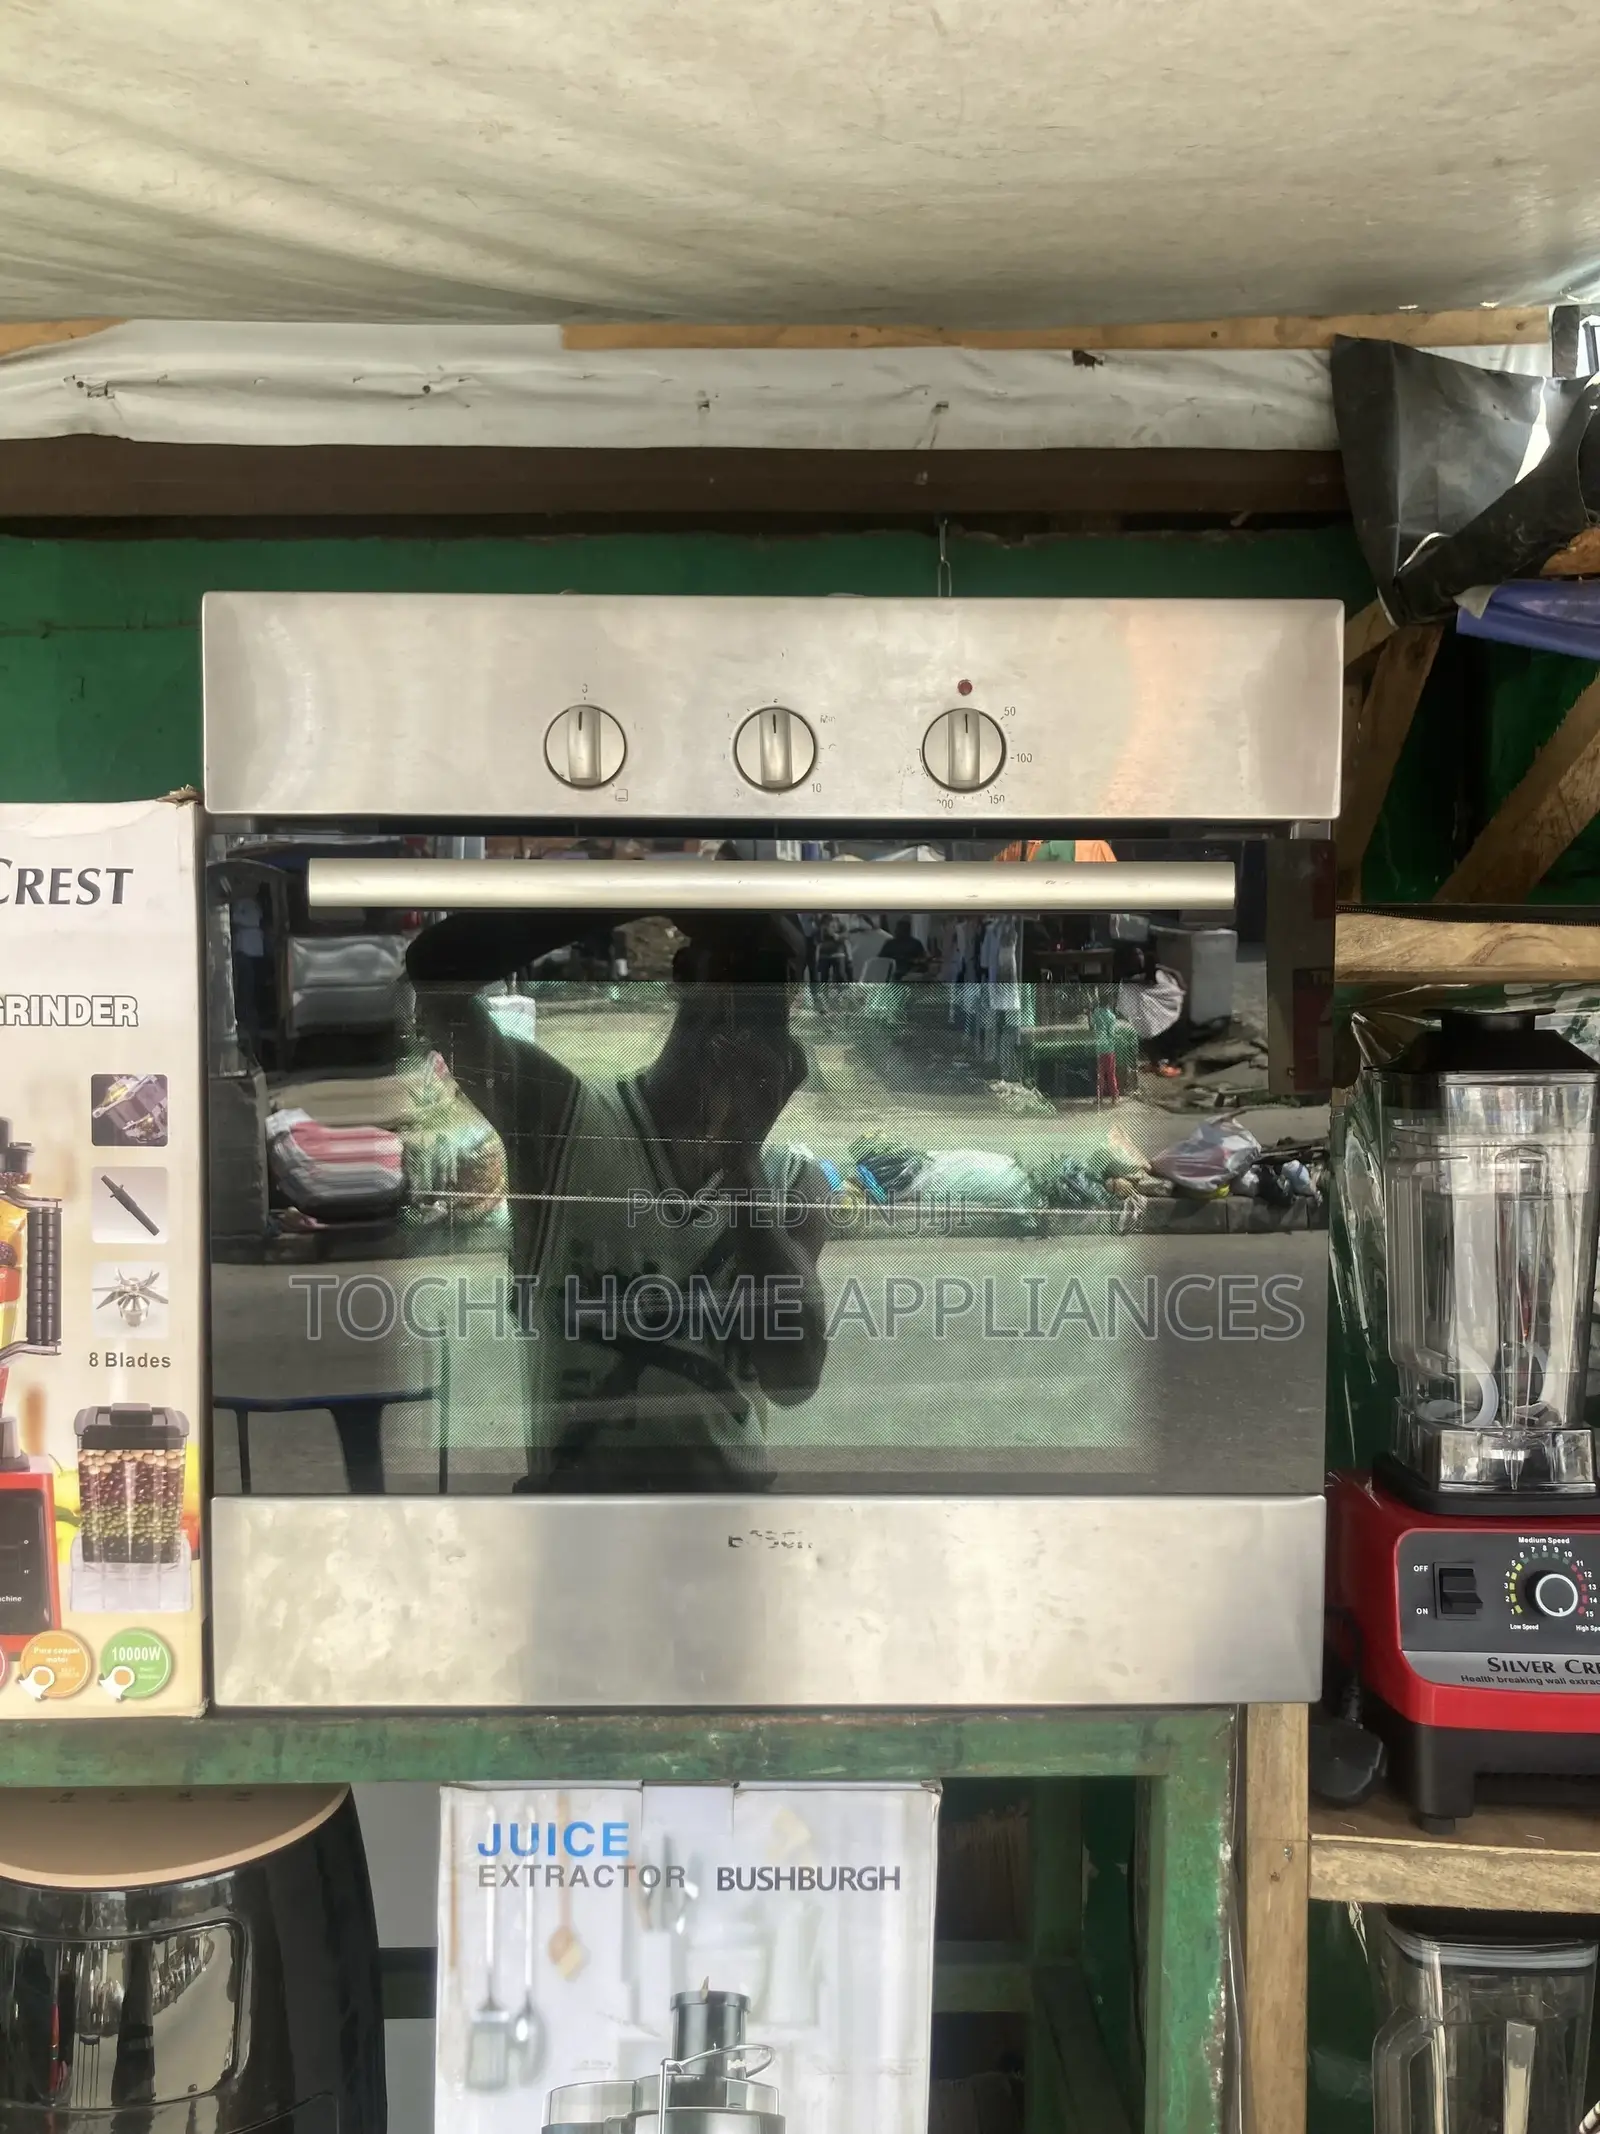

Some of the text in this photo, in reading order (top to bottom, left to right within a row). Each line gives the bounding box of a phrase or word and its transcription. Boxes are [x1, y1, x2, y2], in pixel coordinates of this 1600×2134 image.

[1004, 706, 1016, 717] 50
[1016, 752, 1033, 763] 100
[811, 782, 822, 793] 10
[0, 994, 139, 1027] RINDER
[89, 1352, 171, 1368] 8 Blades
[112, 1647, 161, 1661] 10000W
[1487, 1657, 1556, 1673] SILVER
[1461, 1675, 1494, 1683] Health
[1497, 1676, 1543, 1685] breaking
[477, 1822, 630, 1857] JUICE
[478, 1865, 685, 1888] EXTRACTOR
[717, 1866, 900, 1892] BUSHBURGH
